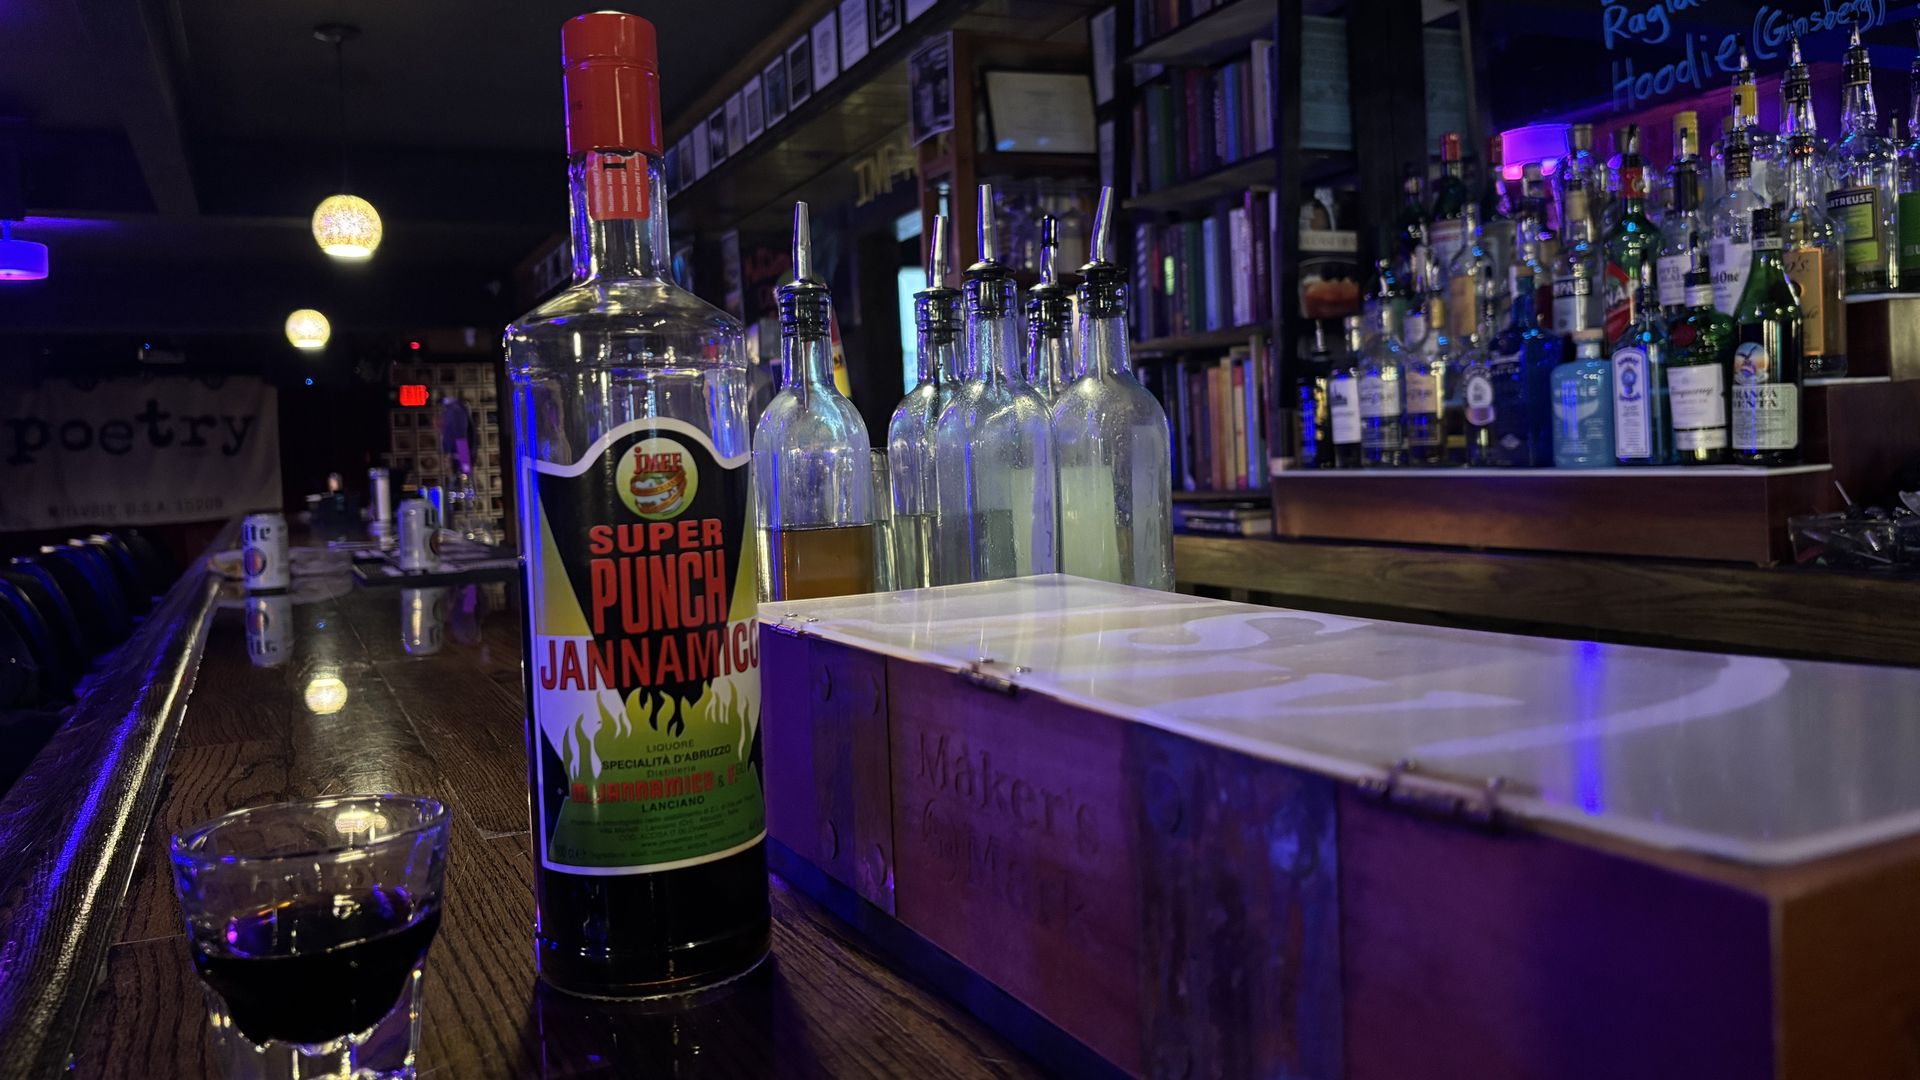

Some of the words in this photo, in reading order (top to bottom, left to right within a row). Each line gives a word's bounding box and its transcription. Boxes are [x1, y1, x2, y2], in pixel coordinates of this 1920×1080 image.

[1611, 33, 1741, 112] Hoodie
[5, 398, 256, 467] poetry
[589, 518, 724, 555] SUPER
[590, 549, 728, 635] PUNCH
[540, 622, 760, 691] JANNAMICO
[602, 754, 671, 770] SPECIALITÀ
[673, 744, 732, 763] D'ABRUZZO
[646, 739, 695, 754] LIQUORE
[646, 765, 697, 778] Distilleria
[641, 795, 705, 813] LANCIANO
